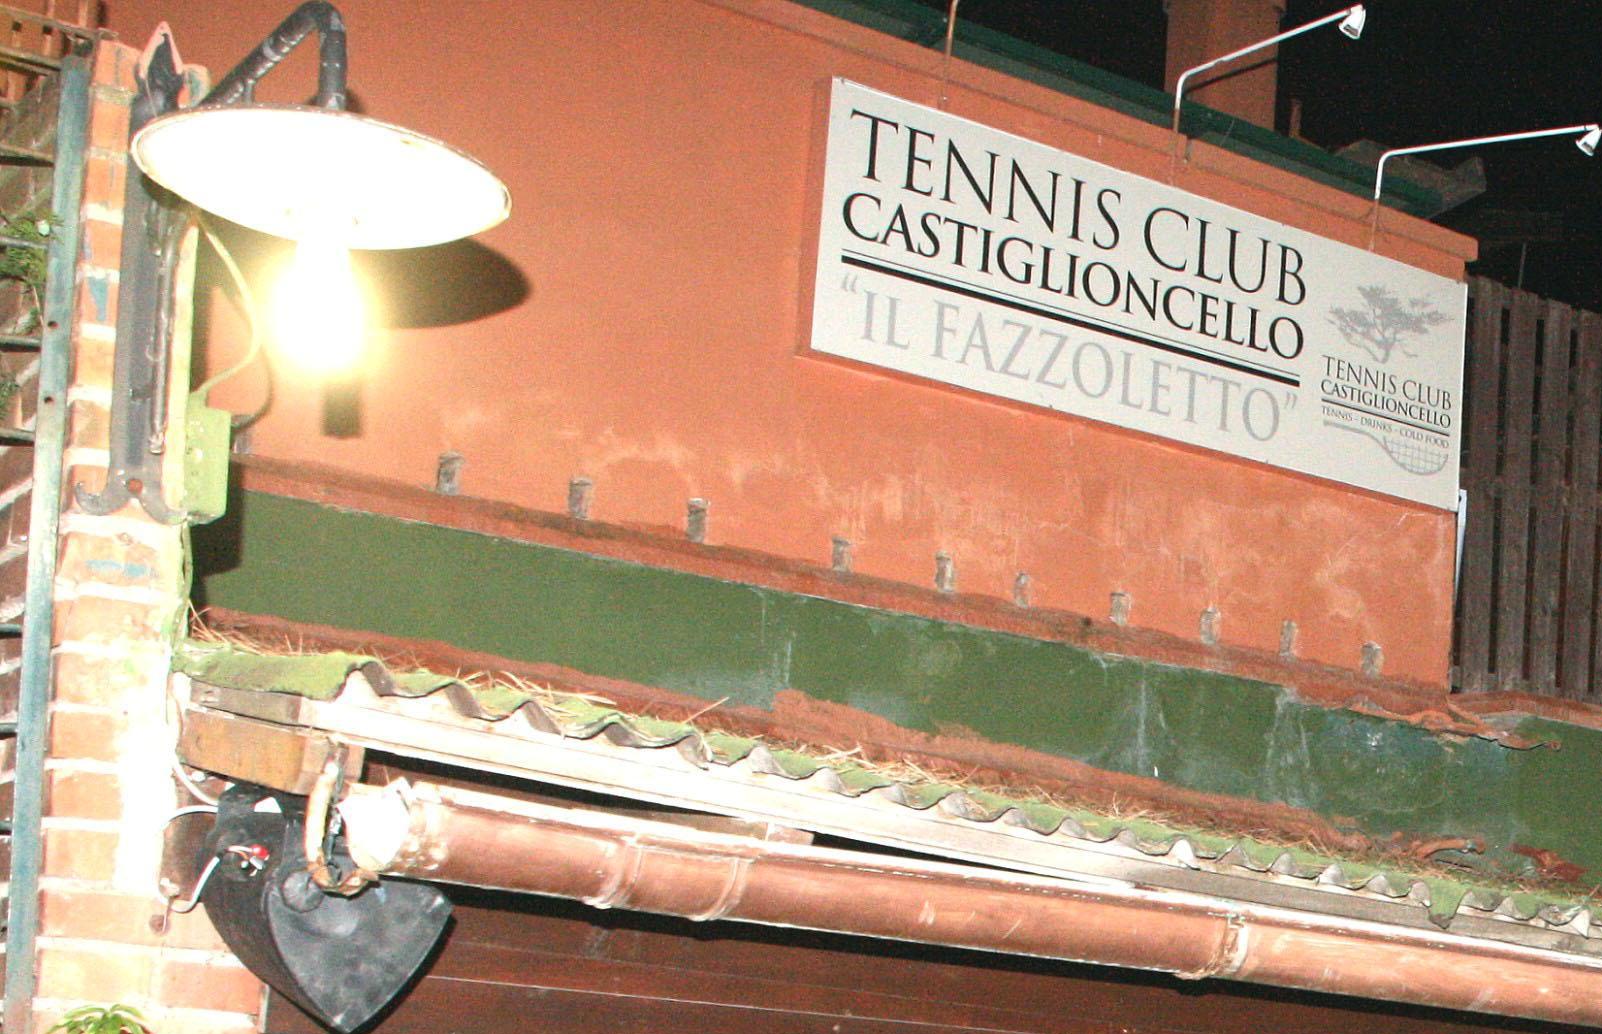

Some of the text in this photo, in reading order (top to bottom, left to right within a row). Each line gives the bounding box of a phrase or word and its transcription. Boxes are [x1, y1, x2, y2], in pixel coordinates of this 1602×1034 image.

[850, 108, 1307, 307] TENNIS CLUB
[841, 191, 1305, 361] CASTIGLIONCELLO
[1320, 378, 1451, 429] CASTIGLIONCELLO
[1321, 354, 1452, 411] TENNIS CLUB
[1321, 405, 1353, 422] TENNIS
[1360, 416, 1393, 433] DRINKS
[1400, 428, 1424, 441] COLD
[1424, 435, 1450, 449] FOOD
